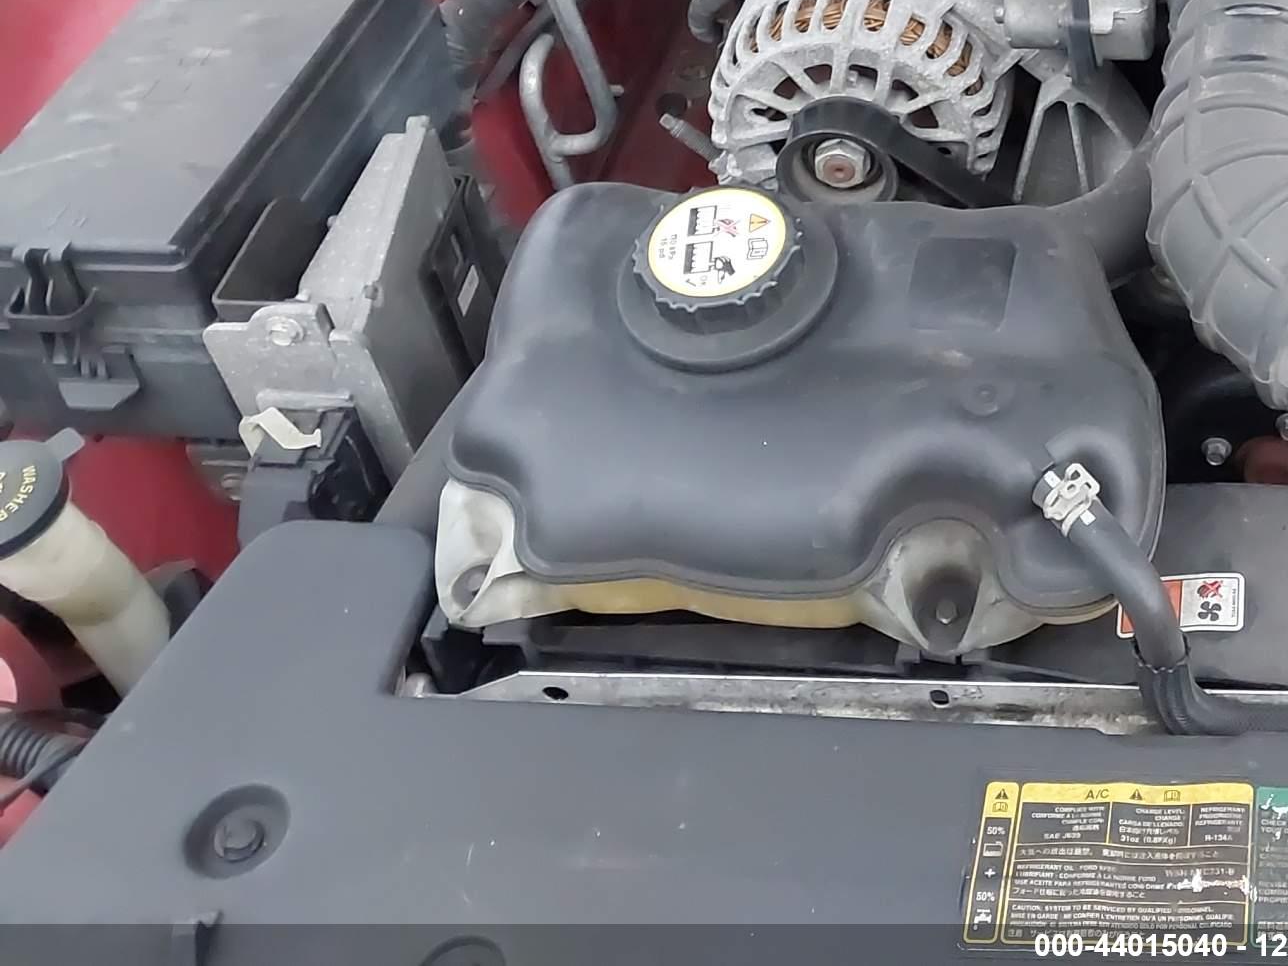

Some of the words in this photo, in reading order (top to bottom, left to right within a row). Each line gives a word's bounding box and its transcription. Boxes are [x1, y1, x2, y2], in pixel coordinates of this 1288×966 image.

[1084, 789, 1109, 800] A/C
[986, 826, 1005, 835] 50%
[976, 891, 995, 902] 50%
